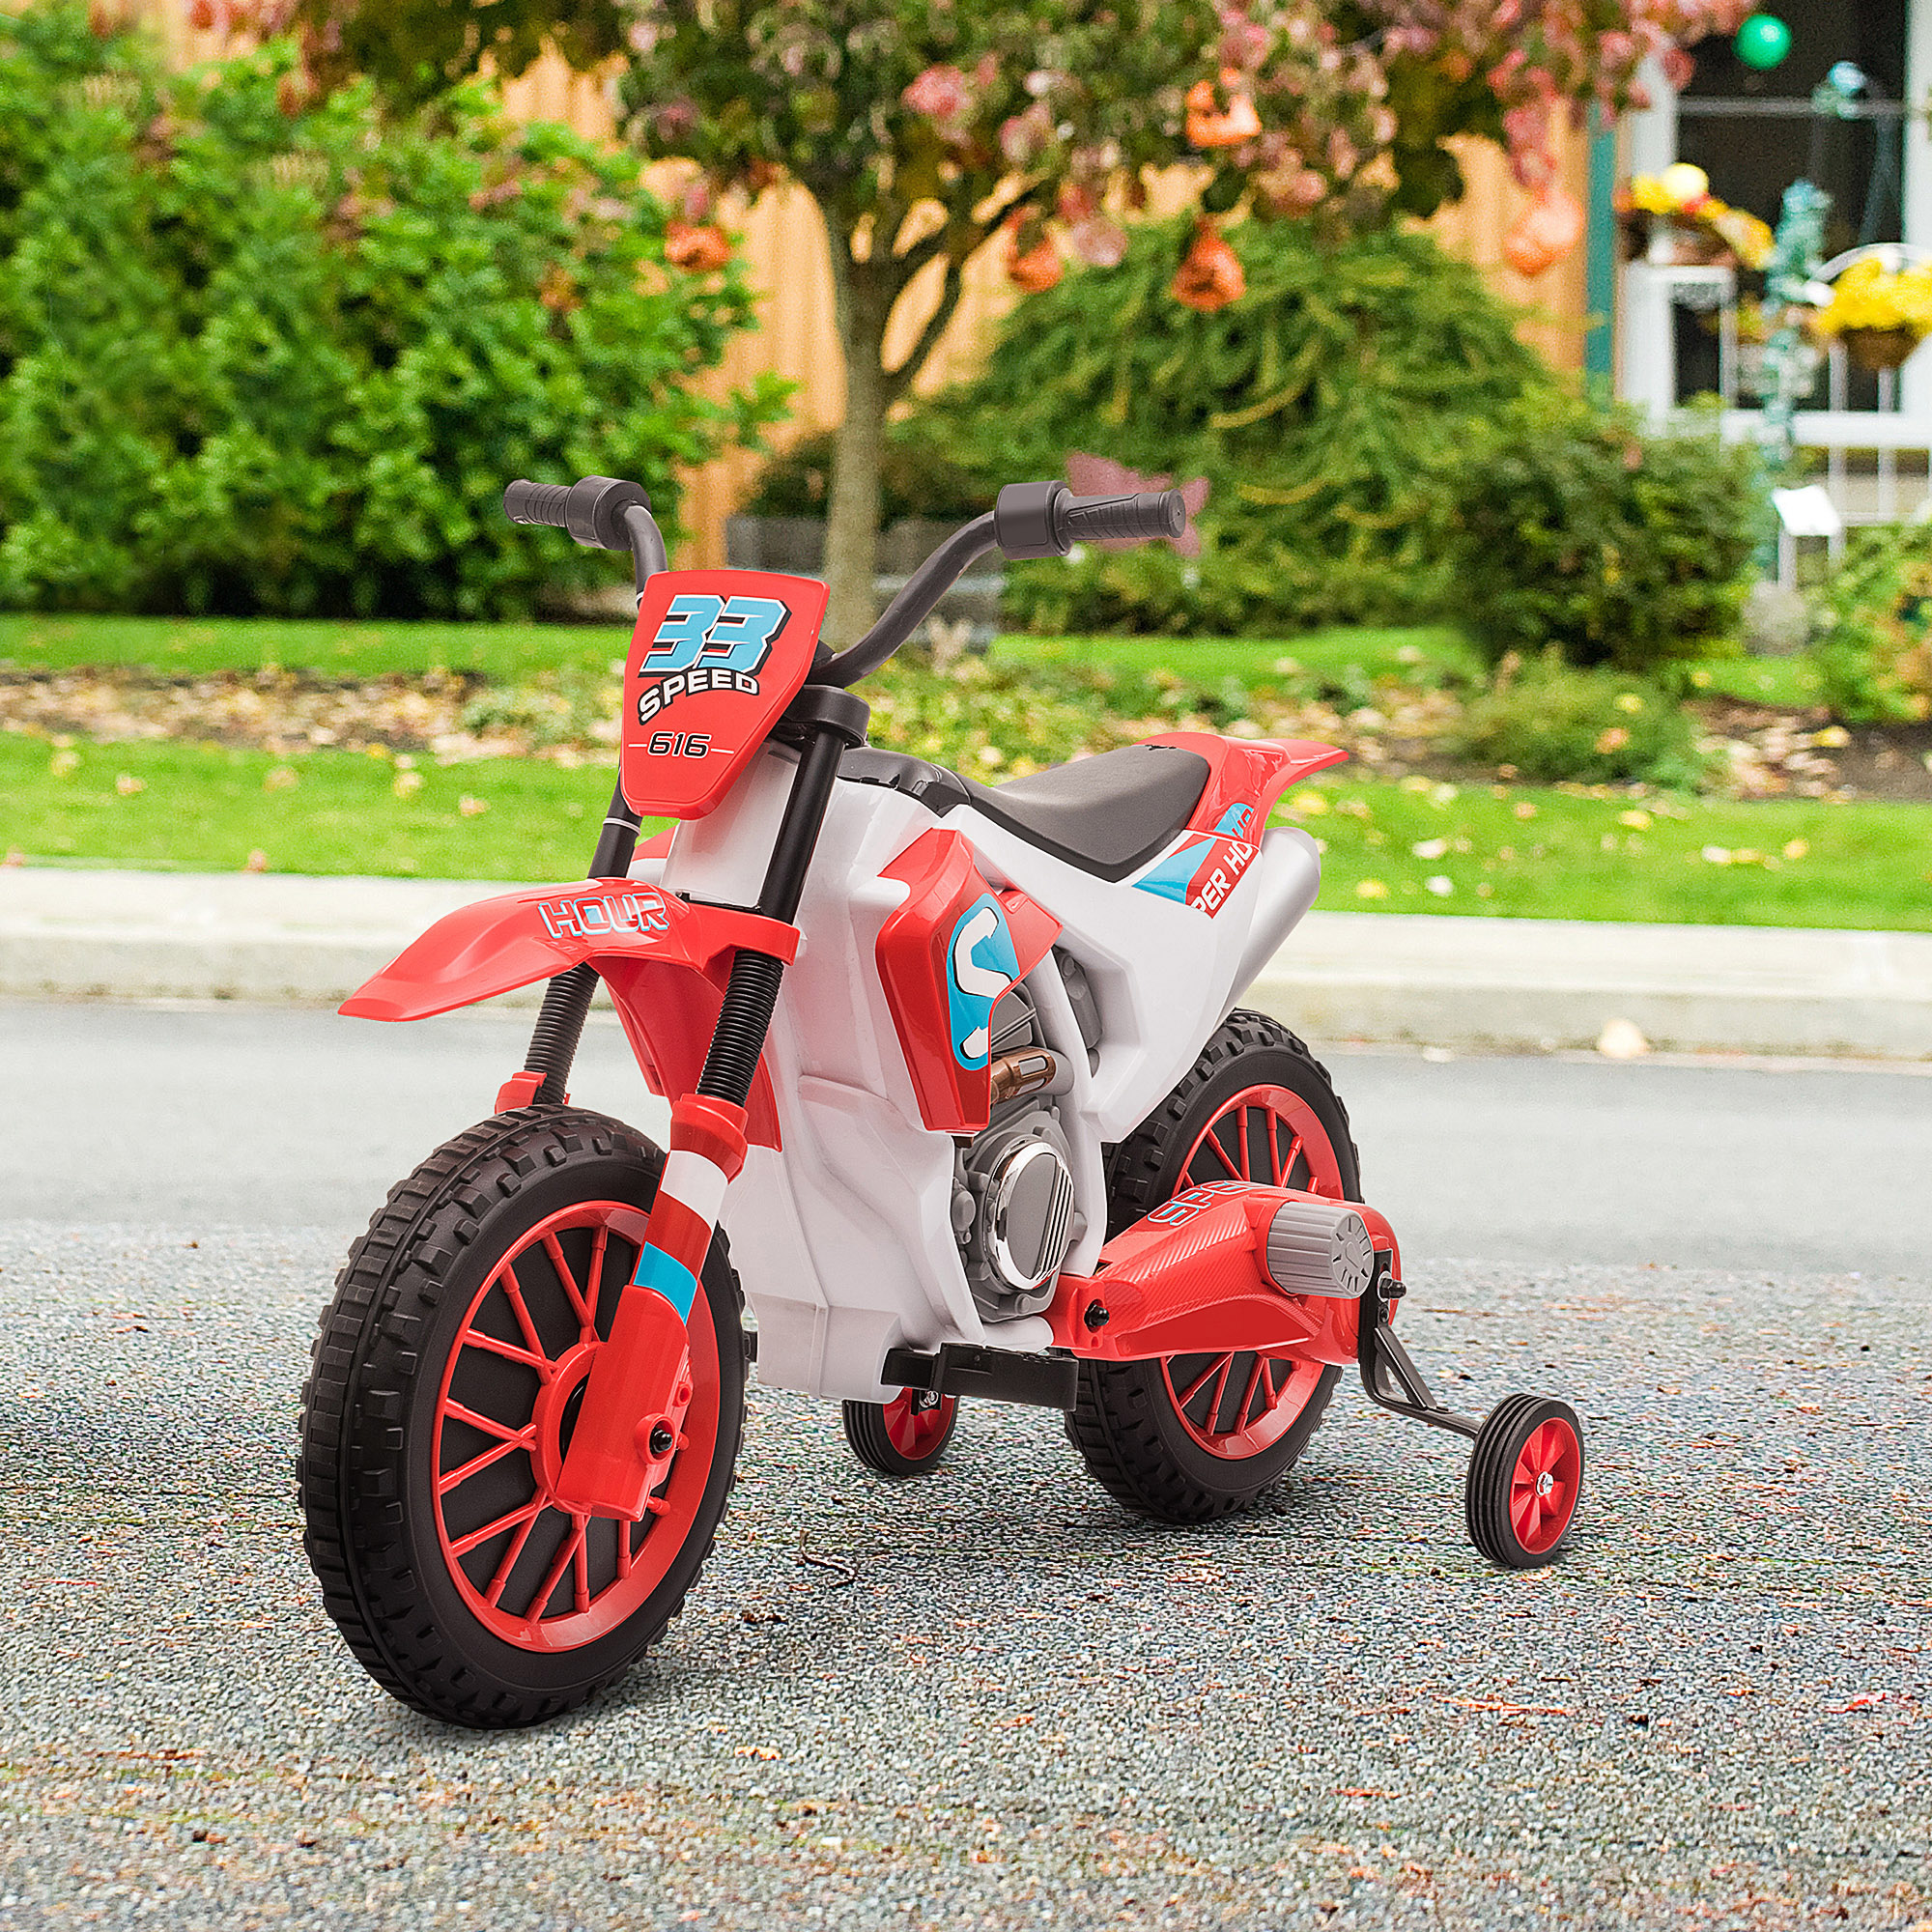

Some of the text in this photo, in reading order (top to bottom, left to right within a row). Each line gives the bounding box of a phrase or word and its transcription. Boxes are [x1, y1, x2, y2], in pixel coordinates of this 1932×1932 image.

[639, 594, 792, 677] 33
[638, 668, 760, 725] SPEED
[647, 731, 713, 759] 616
[538, 892, 670, 939] HOUR
[1147, 1179, 1260, 1227] SPE
